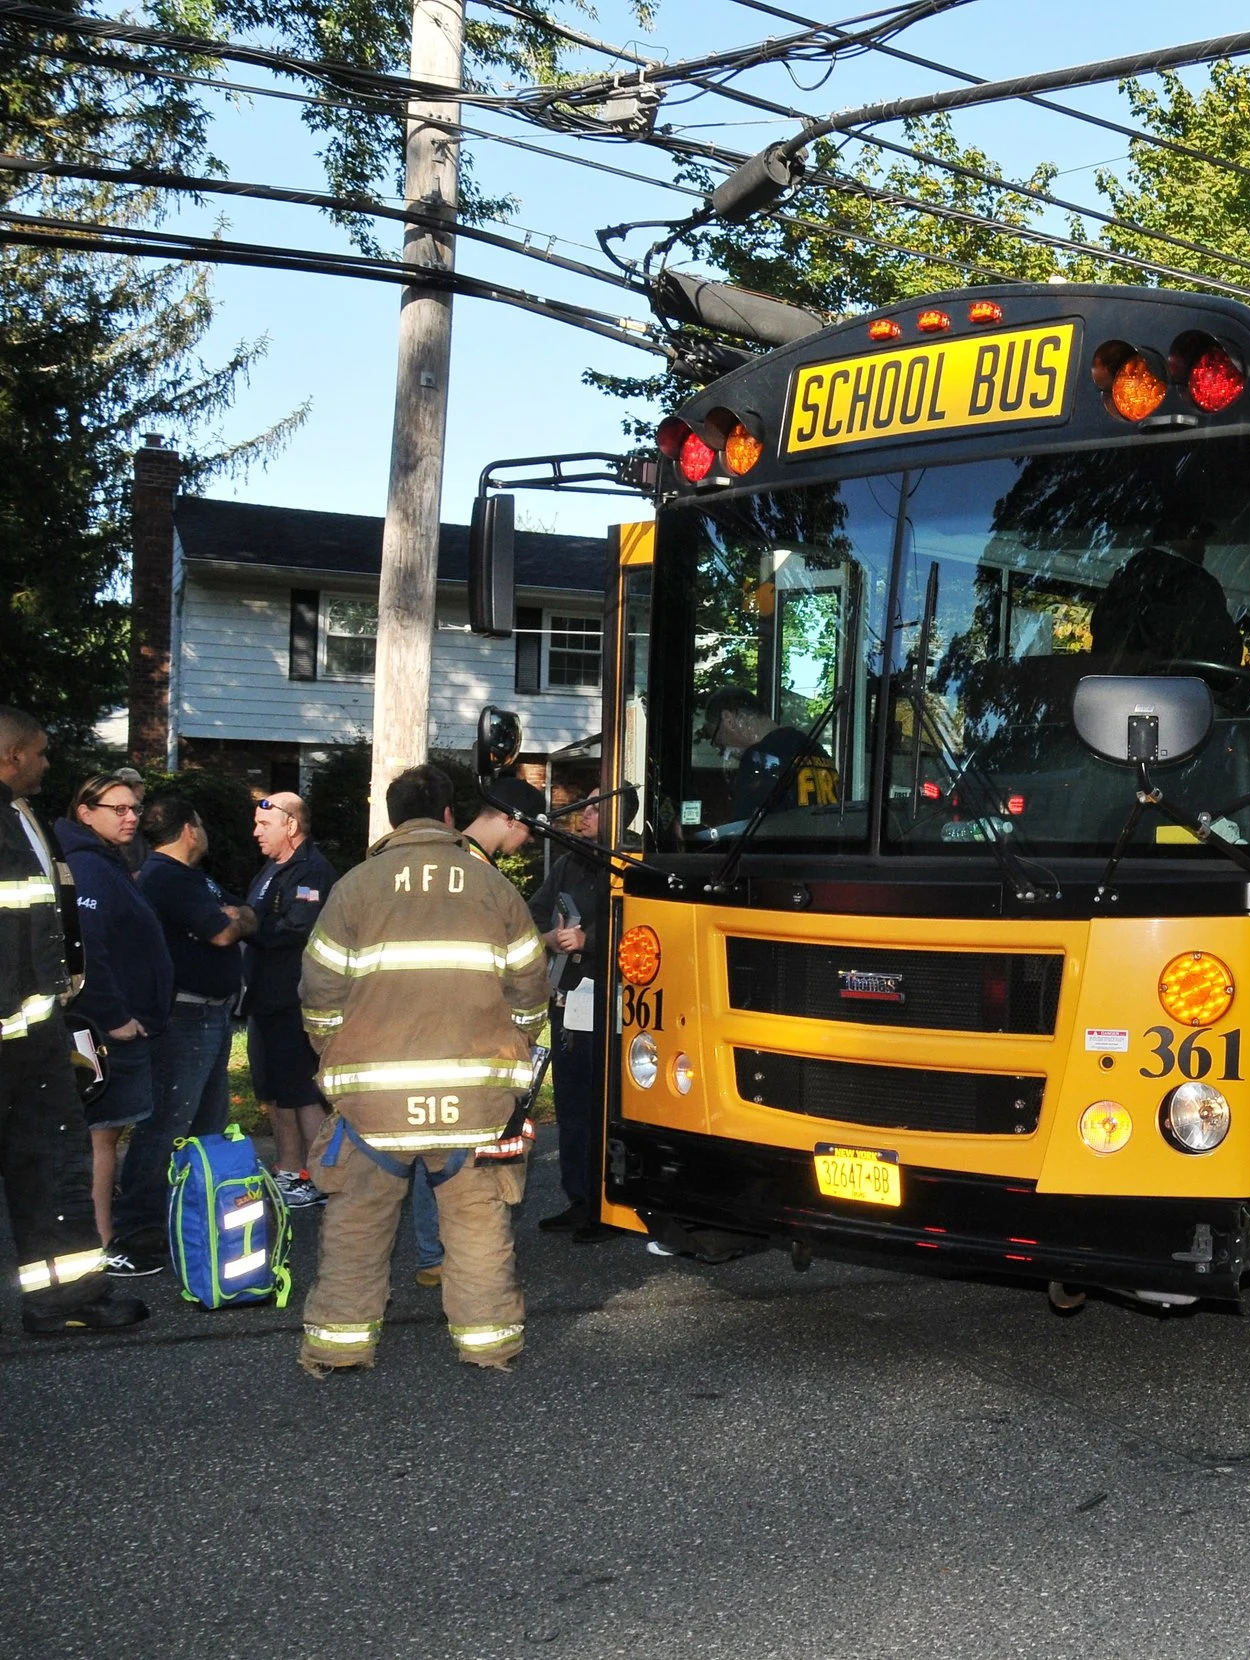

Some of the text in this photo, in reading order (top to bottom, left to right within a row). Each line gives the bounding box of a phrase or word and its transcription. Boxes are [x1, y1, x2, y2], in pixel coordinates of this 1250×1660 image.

[797, 336, 1061, 442] SCHOOL BUS
[622, 985, 664, 1031] 361
[1139, 1025, 1245, 1081] 361
[407, 1095, 460, 1125] 516
[834, 1148, 878, 1161] NEW YORK
